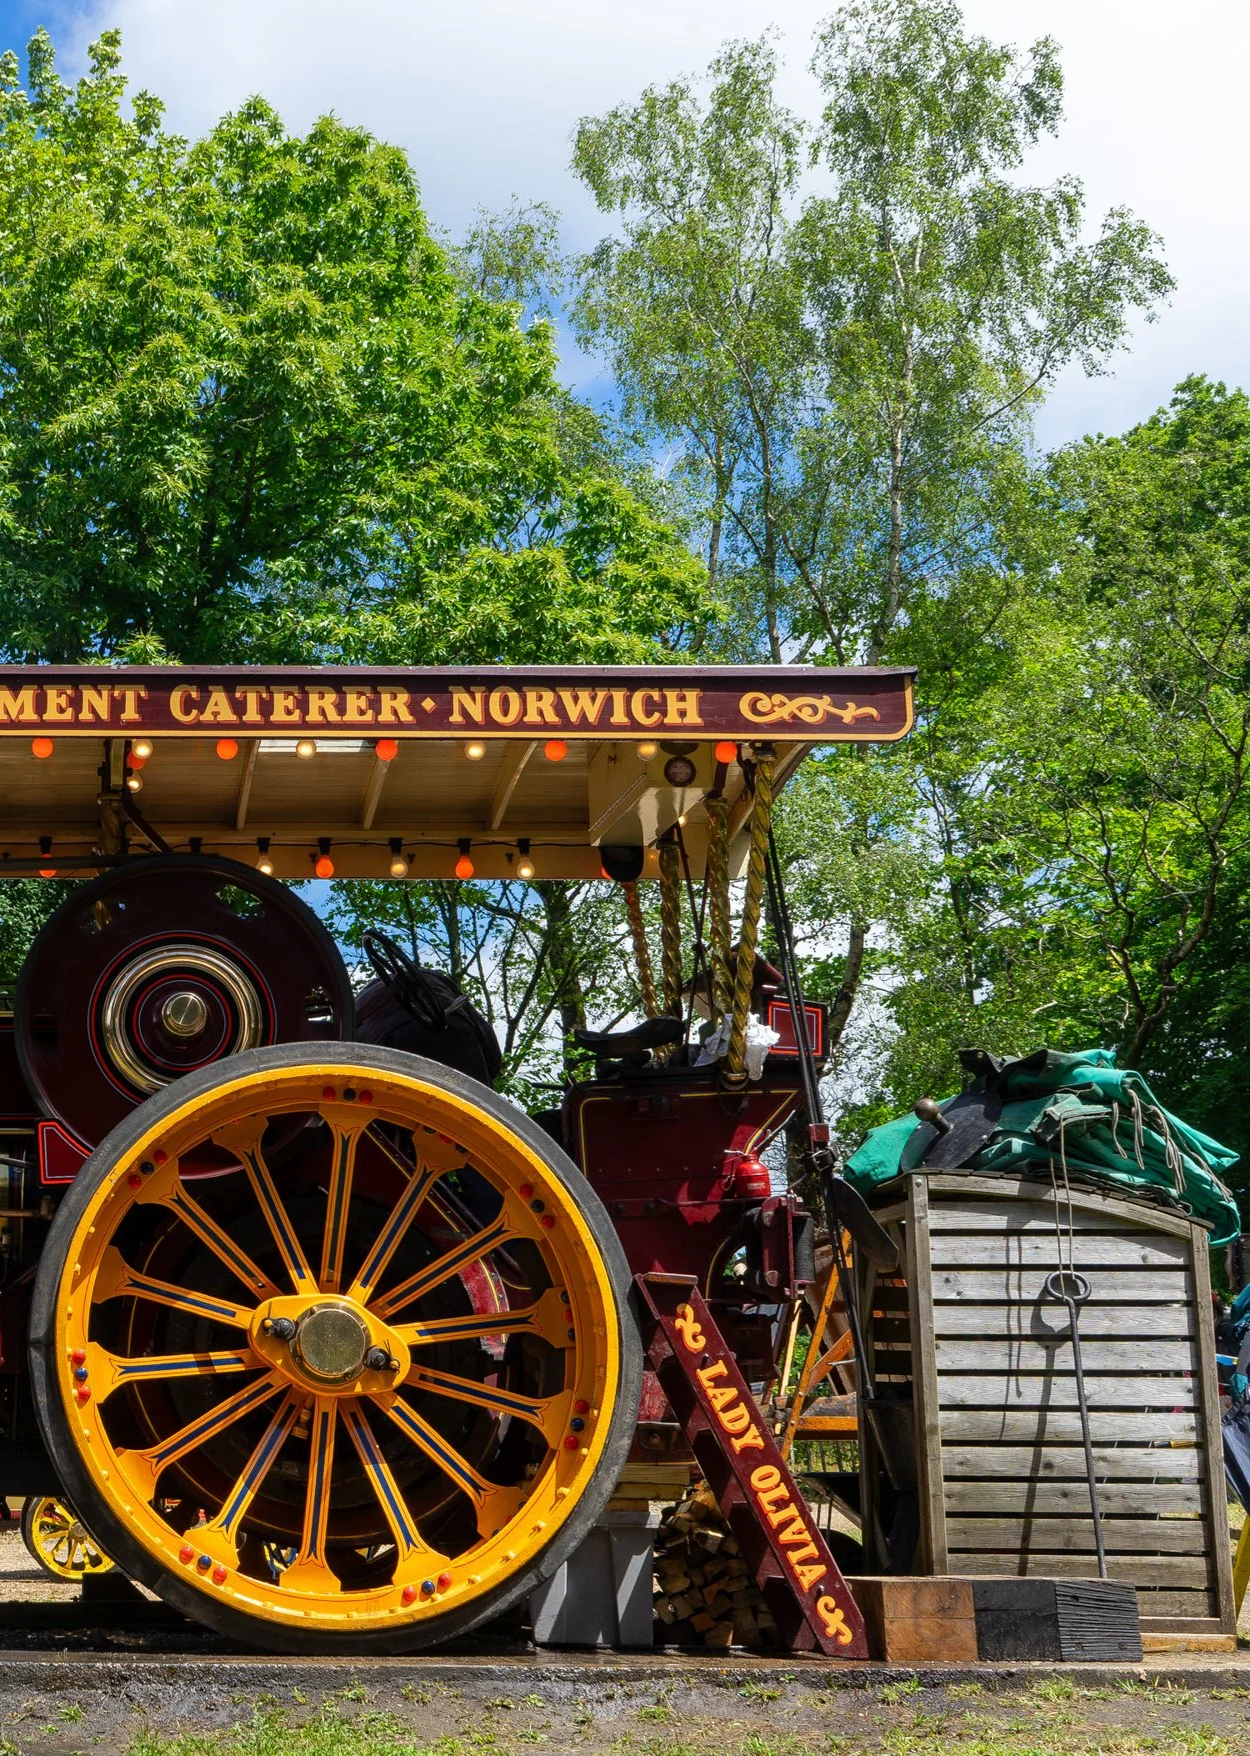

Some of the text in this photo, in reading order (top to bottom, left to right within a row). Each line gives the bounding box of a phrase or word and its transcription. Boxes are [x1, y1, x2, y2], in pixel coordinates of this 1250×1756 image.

[169, 685, 418, 725] CATERER
[449, 686, 705, 726] NORWICH
[695, 1359, 828, 1594] LADY OLIVIA
